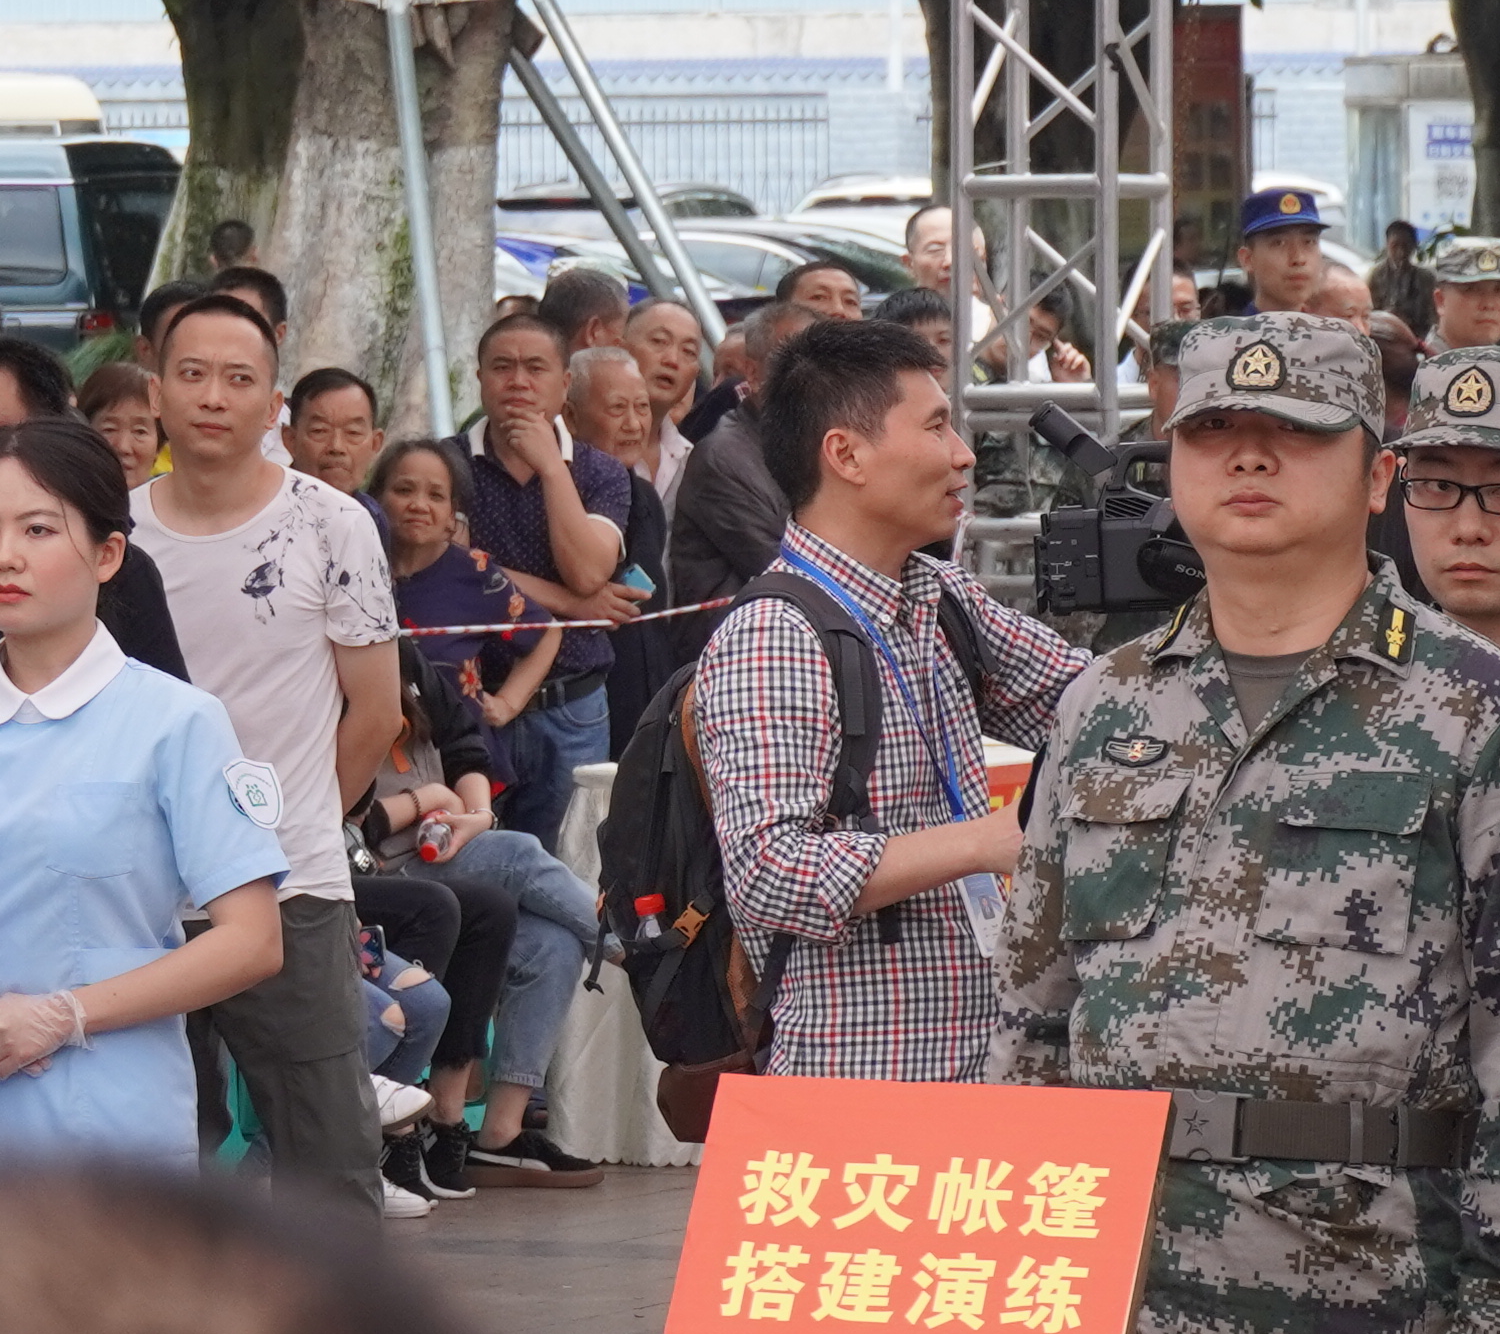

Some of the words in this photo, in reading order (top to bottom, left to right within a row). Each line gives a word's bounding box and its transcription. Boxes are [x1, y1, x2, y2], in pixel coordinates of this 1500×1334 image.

[1174, 563, 1206, 580] SON
[738, 1150, 1110, 1239] 救灾帐篷
[719, 1242, 1089, 1334] 搭建演练
